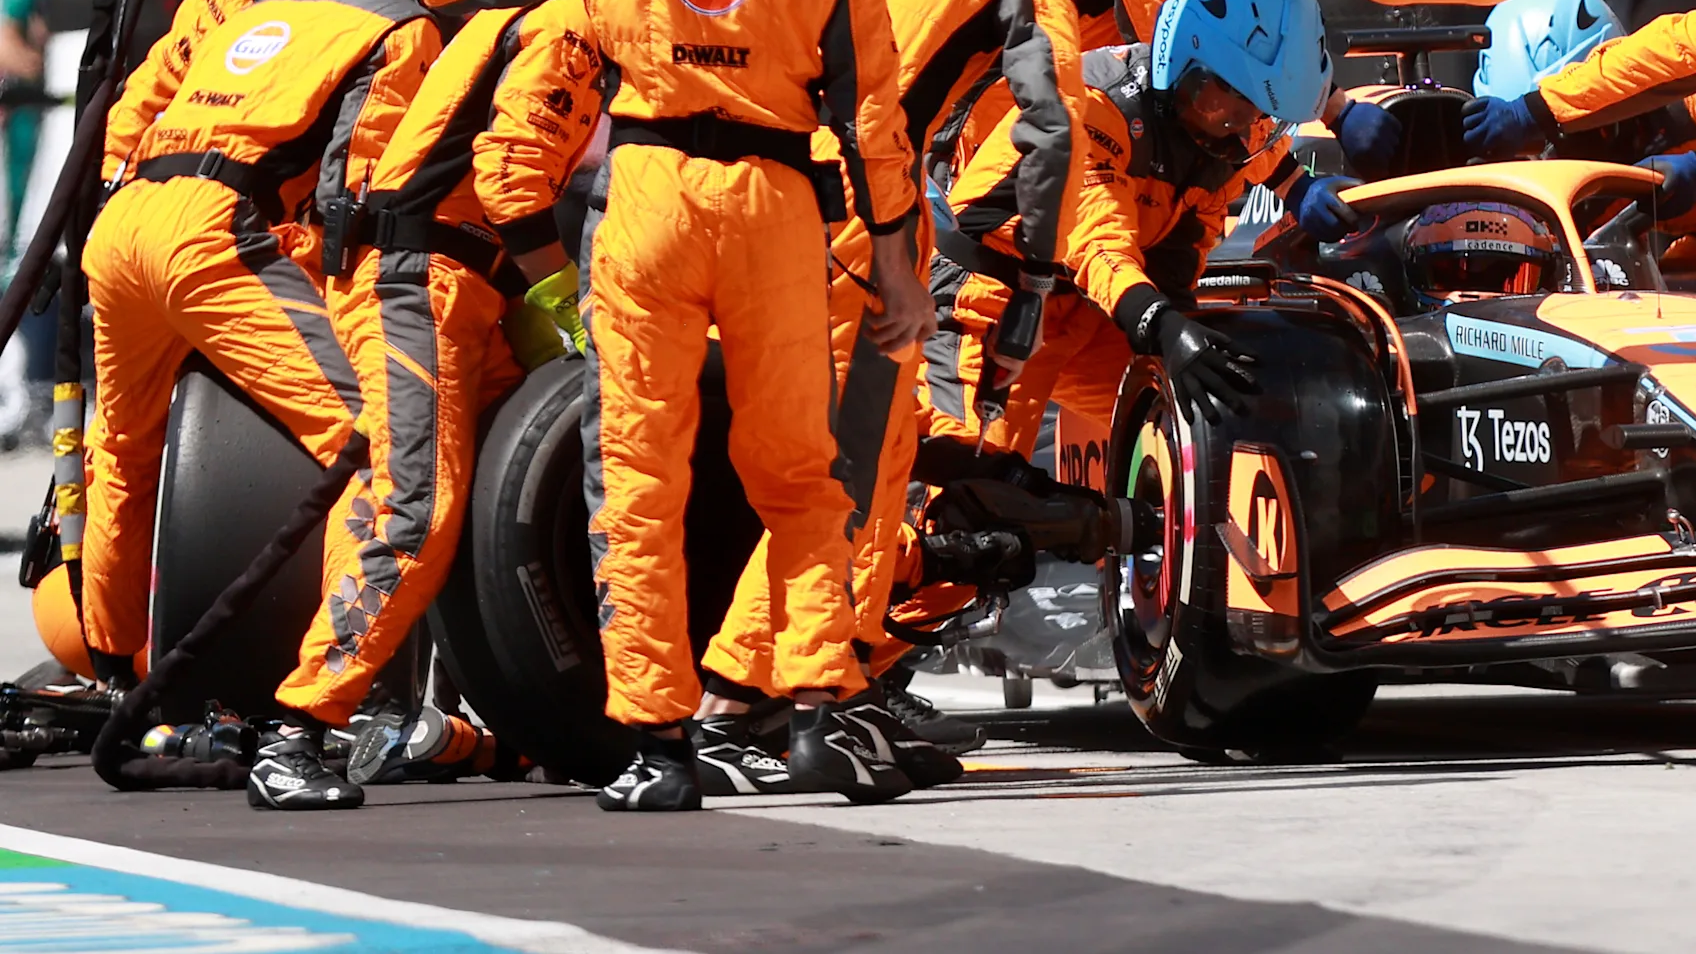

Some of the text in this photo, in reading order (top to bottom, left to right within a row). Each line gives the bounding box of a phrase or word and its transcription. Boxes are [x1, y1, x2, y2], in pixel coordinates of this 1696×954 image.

[234, 38, 285, 55] Gulf
[674, 45, 750, 67] DeWALT
[1263, 79, 1279, 112] Medallia
[1466, 221, 1507, 235] OKX
[1467, 240, 1514, 252] cadence
[1456, 325, 1545, 360] RICHARD MILLE
[1487, 409, 1552, 464] Tezos
[741, 753, 789, 771] sparc
